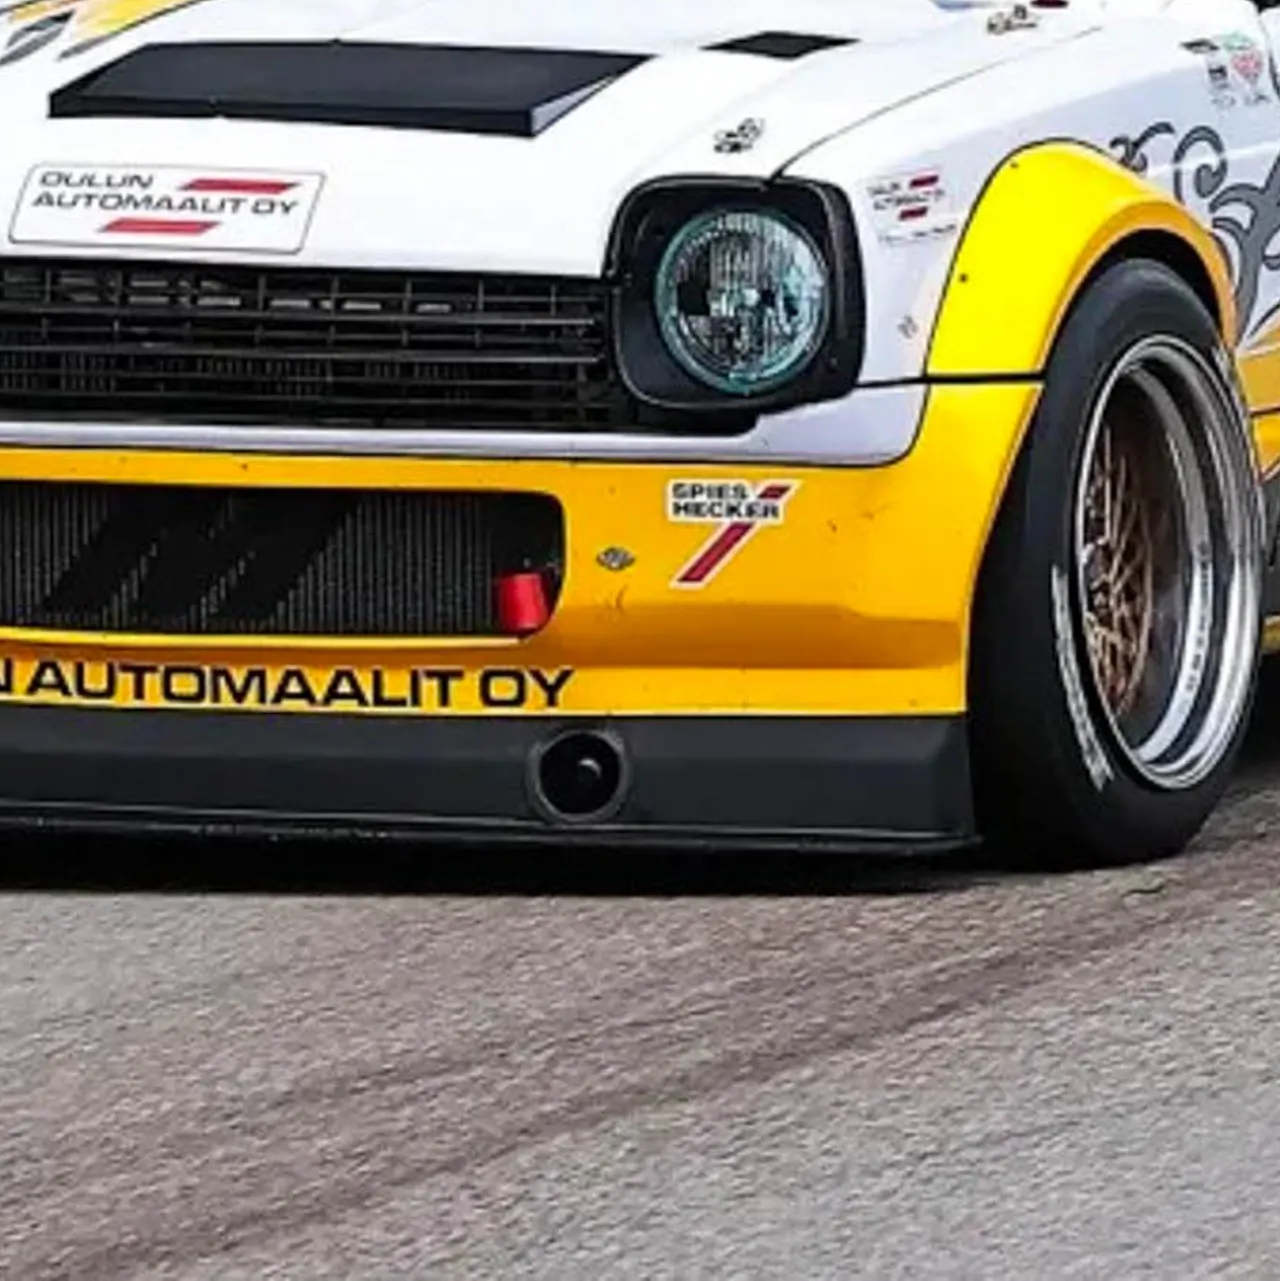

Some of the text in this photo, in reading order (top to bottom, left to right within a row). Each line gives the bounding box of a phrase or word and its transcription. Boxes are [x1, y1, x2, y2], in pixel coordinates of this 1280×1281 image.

[38, 170, 154, 190] OULUN
[31, 191, 300, 215] AUTOMAALIT OY
[672, 483, 749, 500] SPIES
[672, 501, 780, 519] HECKER
[24, 656, 467, 710] AUTOMAALIT
[477, 667, 576, 710] OY
